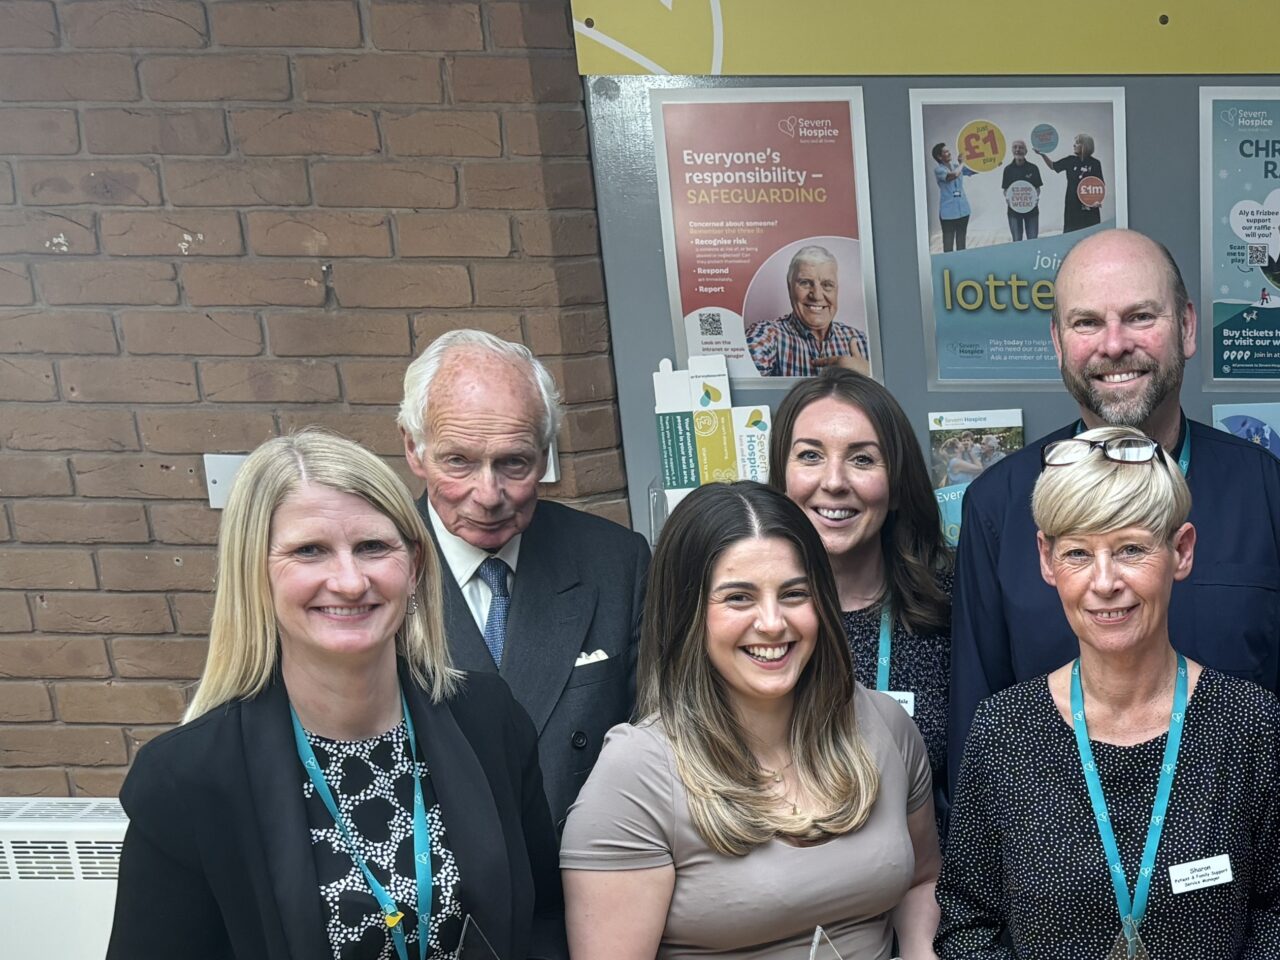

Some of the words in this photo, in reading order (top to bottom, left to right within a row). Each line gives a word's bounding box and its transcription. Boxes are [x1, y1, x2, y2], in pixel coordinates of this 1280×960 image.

[1238, 109, 1267, 118] Severn
[798, 118, 832, 127] Severn
[1238, 118, 1273, 128] Hospice
[799, 127, 839, 138] Hospice
[964, 129, 999, 160] £1
[683, 148, 781, 168] Everyone's
[685, 166, 807, 187] responsibility
[1080, 185, 1103, 195] £1m
[687, 188, 828, 204] SAFEGUARDING
[1238, 210, 1249, 218] Aly
[1258, 232, 1272, 240] you?
[695, 238, 732, 246] Recognise
[697, 267, 729, 275] Respond
[1223, 329, 1240, 338] Buy
[1242, 328, 1274, 337] tickets
[1234, 338, 1254, 346] visit
[746, 434, 760, 481] Hospice
[757, 434, 768, 474] Severn
[1190, 866, 1212, 874] Sharon
